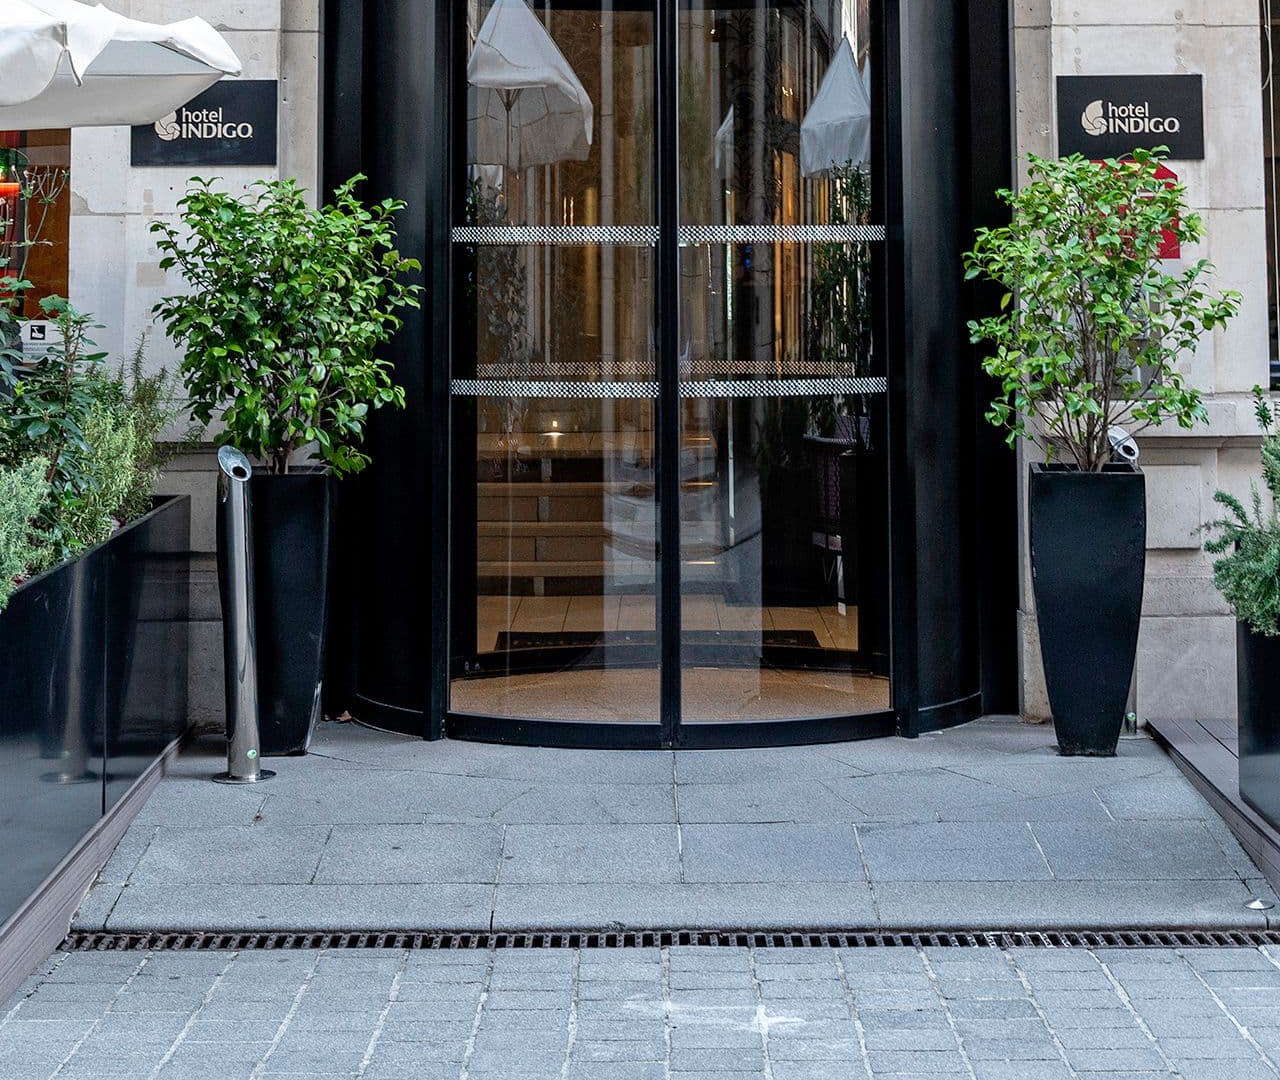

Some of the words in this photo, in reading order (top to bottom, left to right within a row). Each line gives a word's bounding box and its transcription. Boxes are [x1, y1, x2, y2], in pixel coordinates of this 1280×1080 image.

[181, 107, 223, 122] hotel
[1108, 101, 1149, 117] hotel
[181, 123, 253, 138] INDIGO
[1108, 117, 1180, 133] INDIGO
